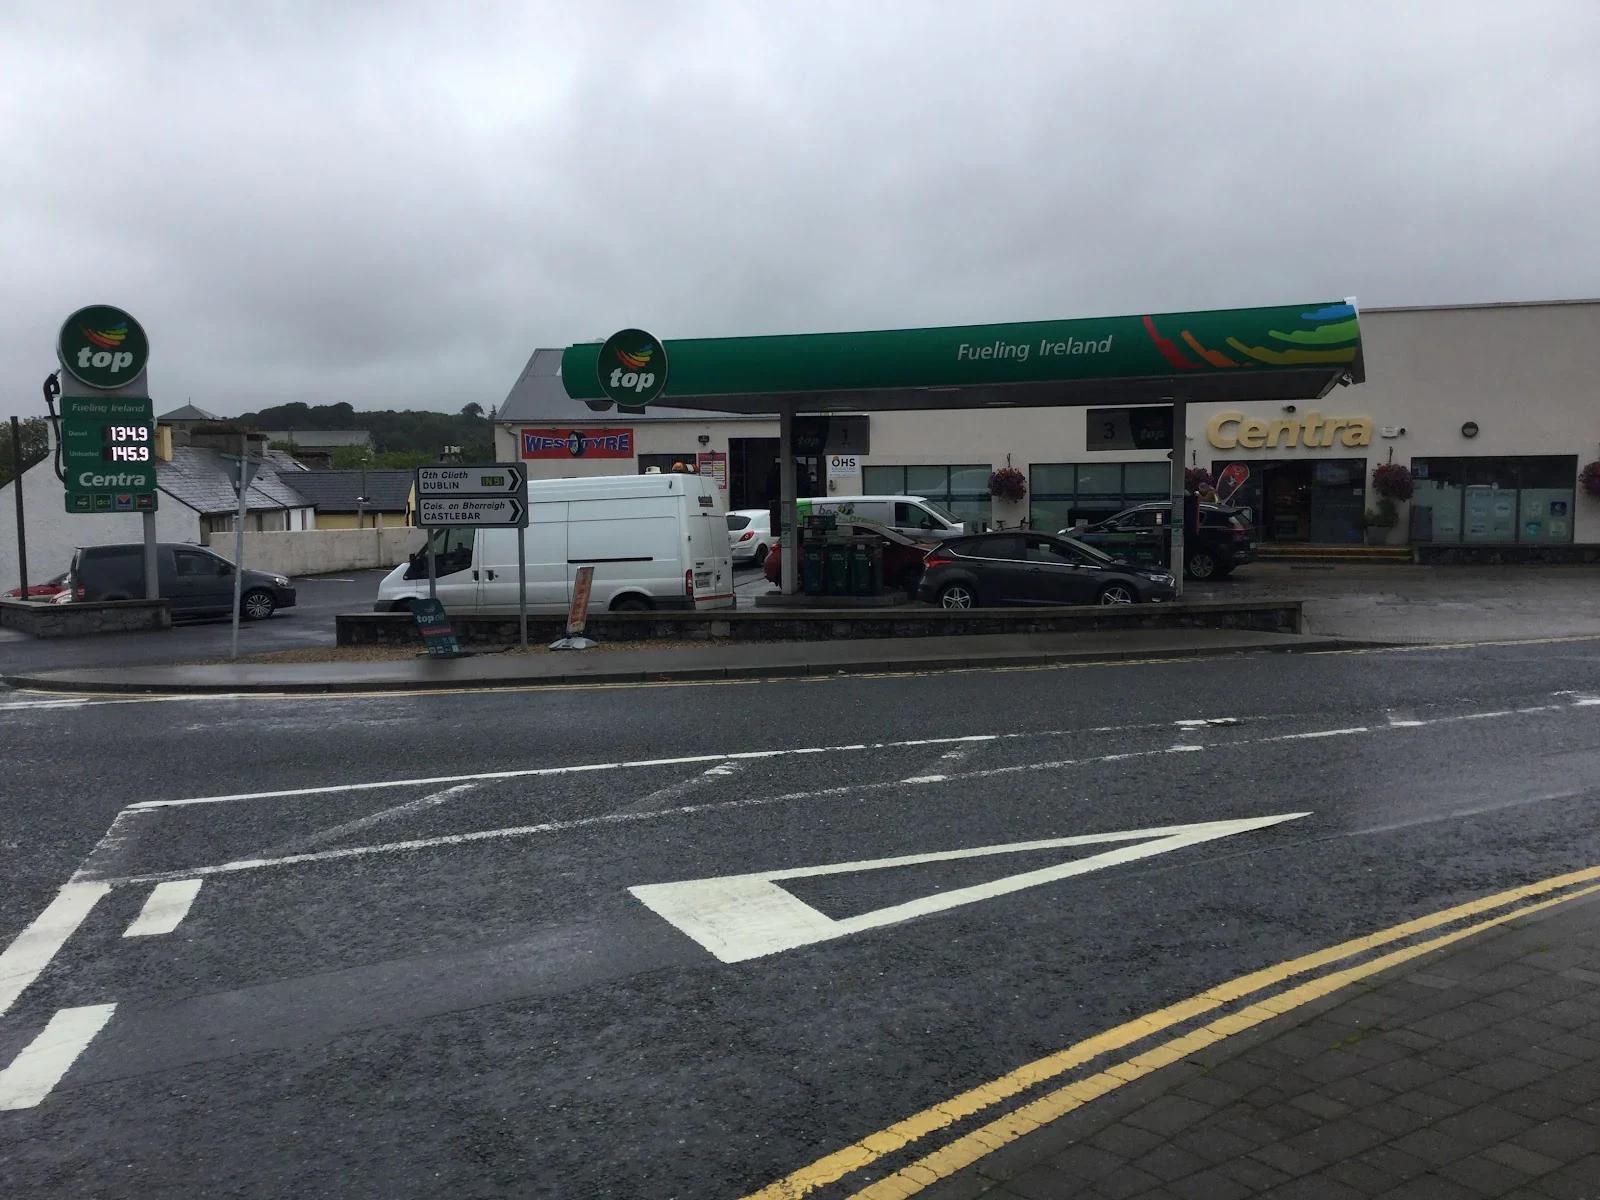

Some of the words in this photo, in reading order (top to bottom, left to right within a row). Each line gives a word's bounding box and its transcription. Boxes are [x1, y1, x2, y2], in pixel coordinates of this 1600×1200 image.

[957, 341, 1030, 362] Fueling
[1039, 335, 1113, 356] Ireland
[77, 346, 133, 372] top
[609, 367, 655, 393] top
[71, 403, 108, 414] Fueling
[111, 403, 145, 413] Ireland
[110, 426, 148, 442] 134.9
[1104, 422, 1116, 440] 3
[1207, 411, 1373, 450] Centra
[523, 433, 577, 453] WEST
[580, 432, 630, 453] TYRE
[111, 446, 150, 462] 145.9
[78, 471, 146, 488] Centra
[441, 470, 469, 479] Cliath
[422, 482, 460, 490] DUBLIN
[462, 501, 505, 512] Bharraigh
[423, 512, 481, 521] CASTLEBAR
[416, 613, 435, 624] top
